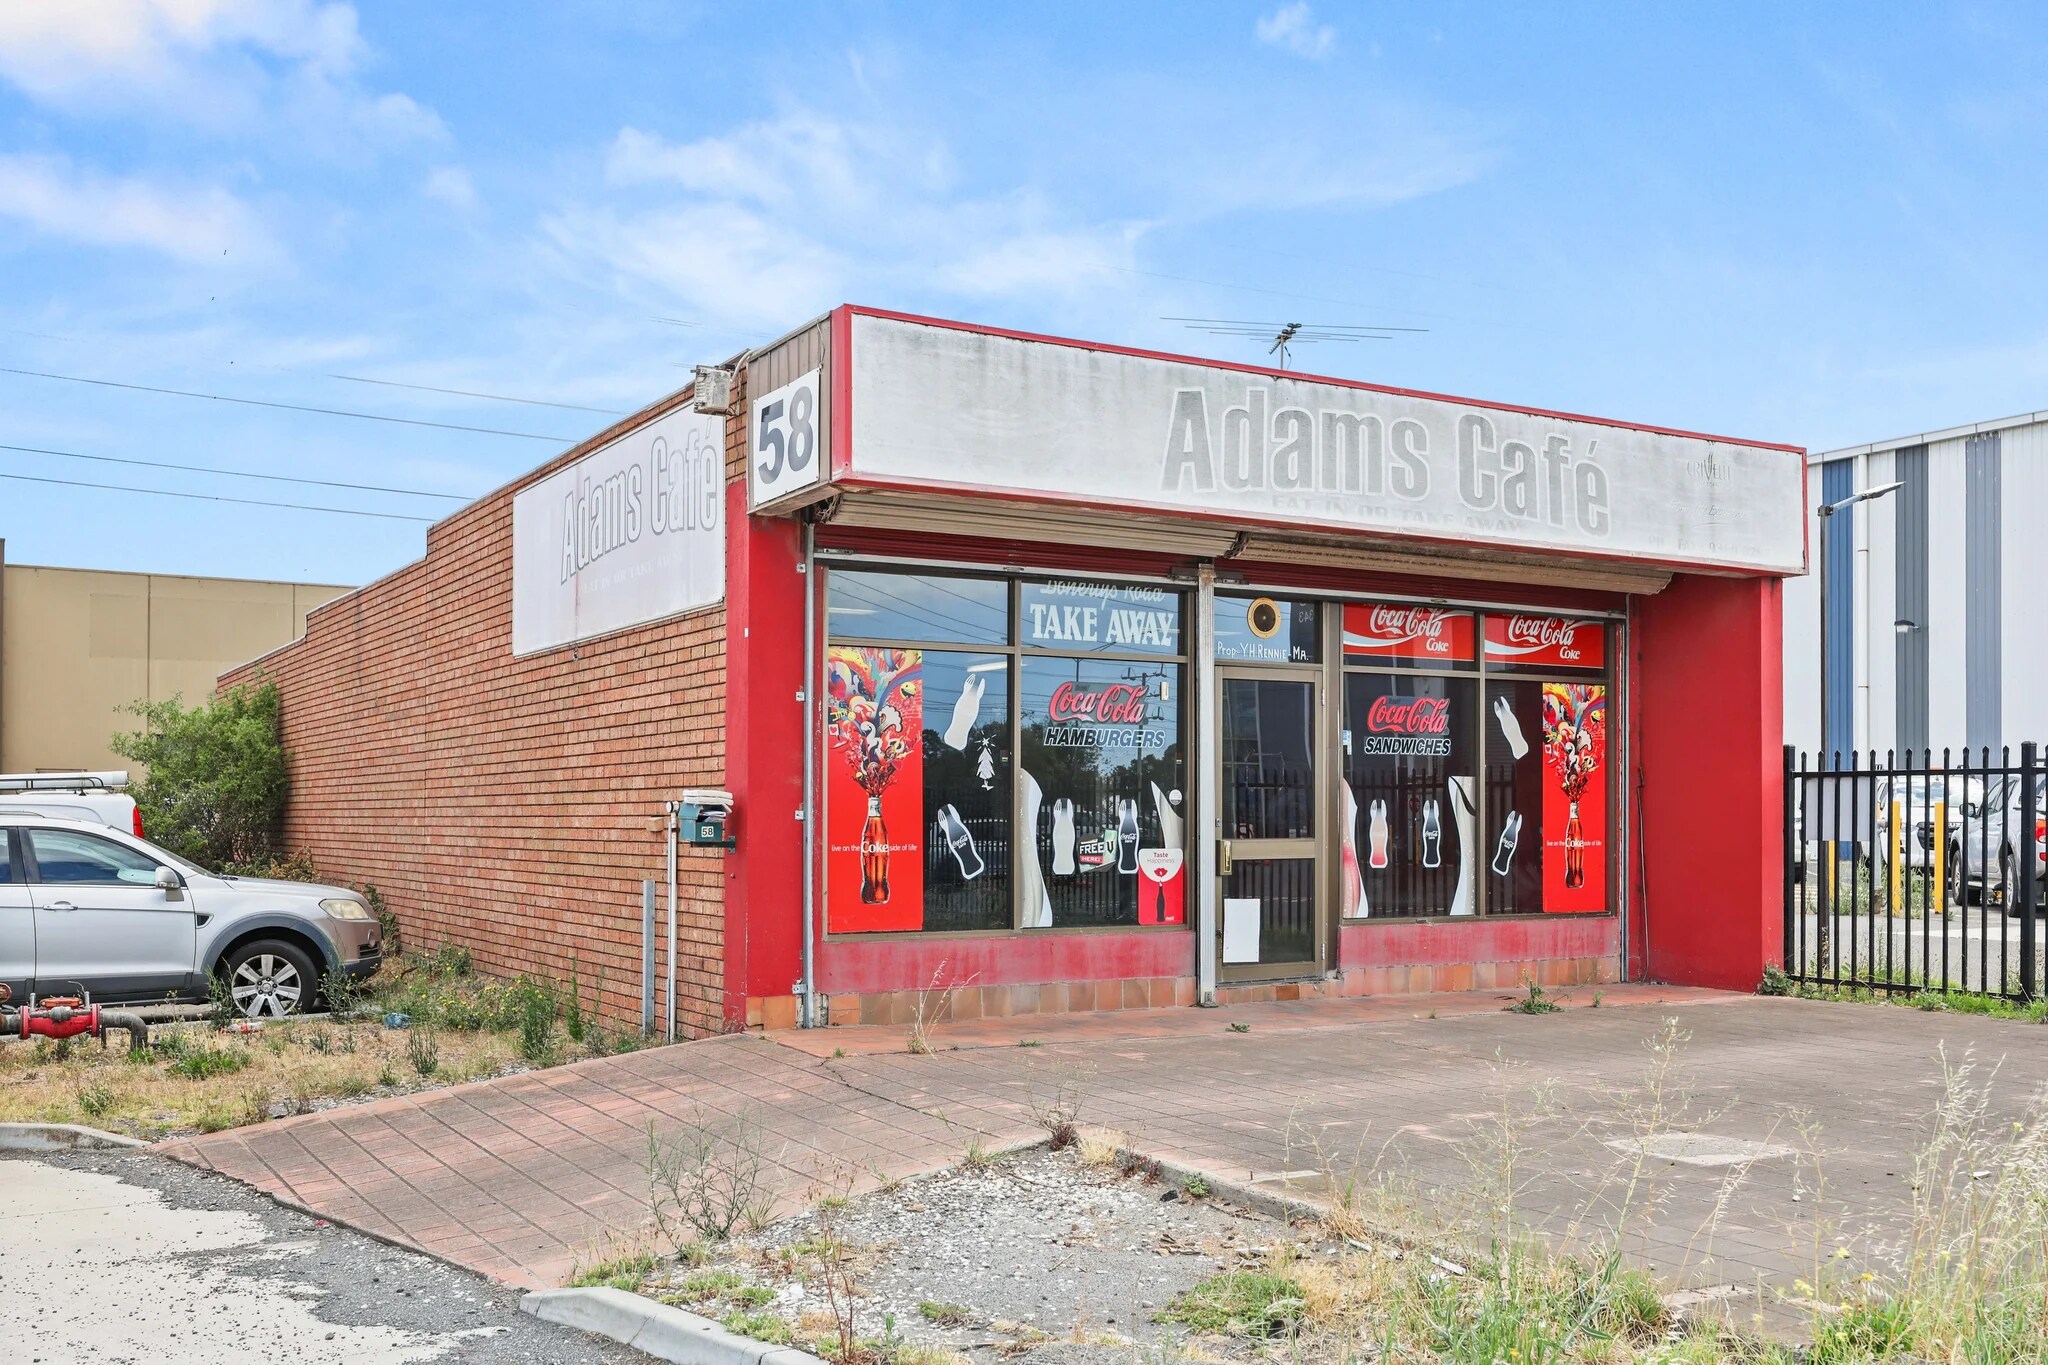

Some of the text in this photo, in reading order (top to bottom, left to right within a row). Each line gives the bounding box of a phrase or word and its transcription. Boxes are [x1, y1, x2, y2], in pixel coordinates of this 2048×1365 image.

[758, 386, 814, 485] 58
[1163, 387, 1611, 538] Adams Café
[560, 418, 718, 585] Adams Café
[1030, 603, 1175, 647] TAKE AWAY
[1426, 638, 1449, 652] Coke
[1559, 646, 1581, 660] Coke
[1049, 681, 1149, 725] Coca-Cola
[1367, 695, 1451, 734] Coca-Cola
[1044, 726, 1166, 748] HAMBURGERS
[1364, 736, 1452, 756] SANDWICHES
[702, 827, 713, 836] 58
[831, 844, 841, 852] live
[851, 844, 861, 852] the
[861, 841, 889, 853] Coke
[889, 843, 900, 851] side
[901, 843, 908, 851] of
[1079, 840, 1114, 855] FREE V
